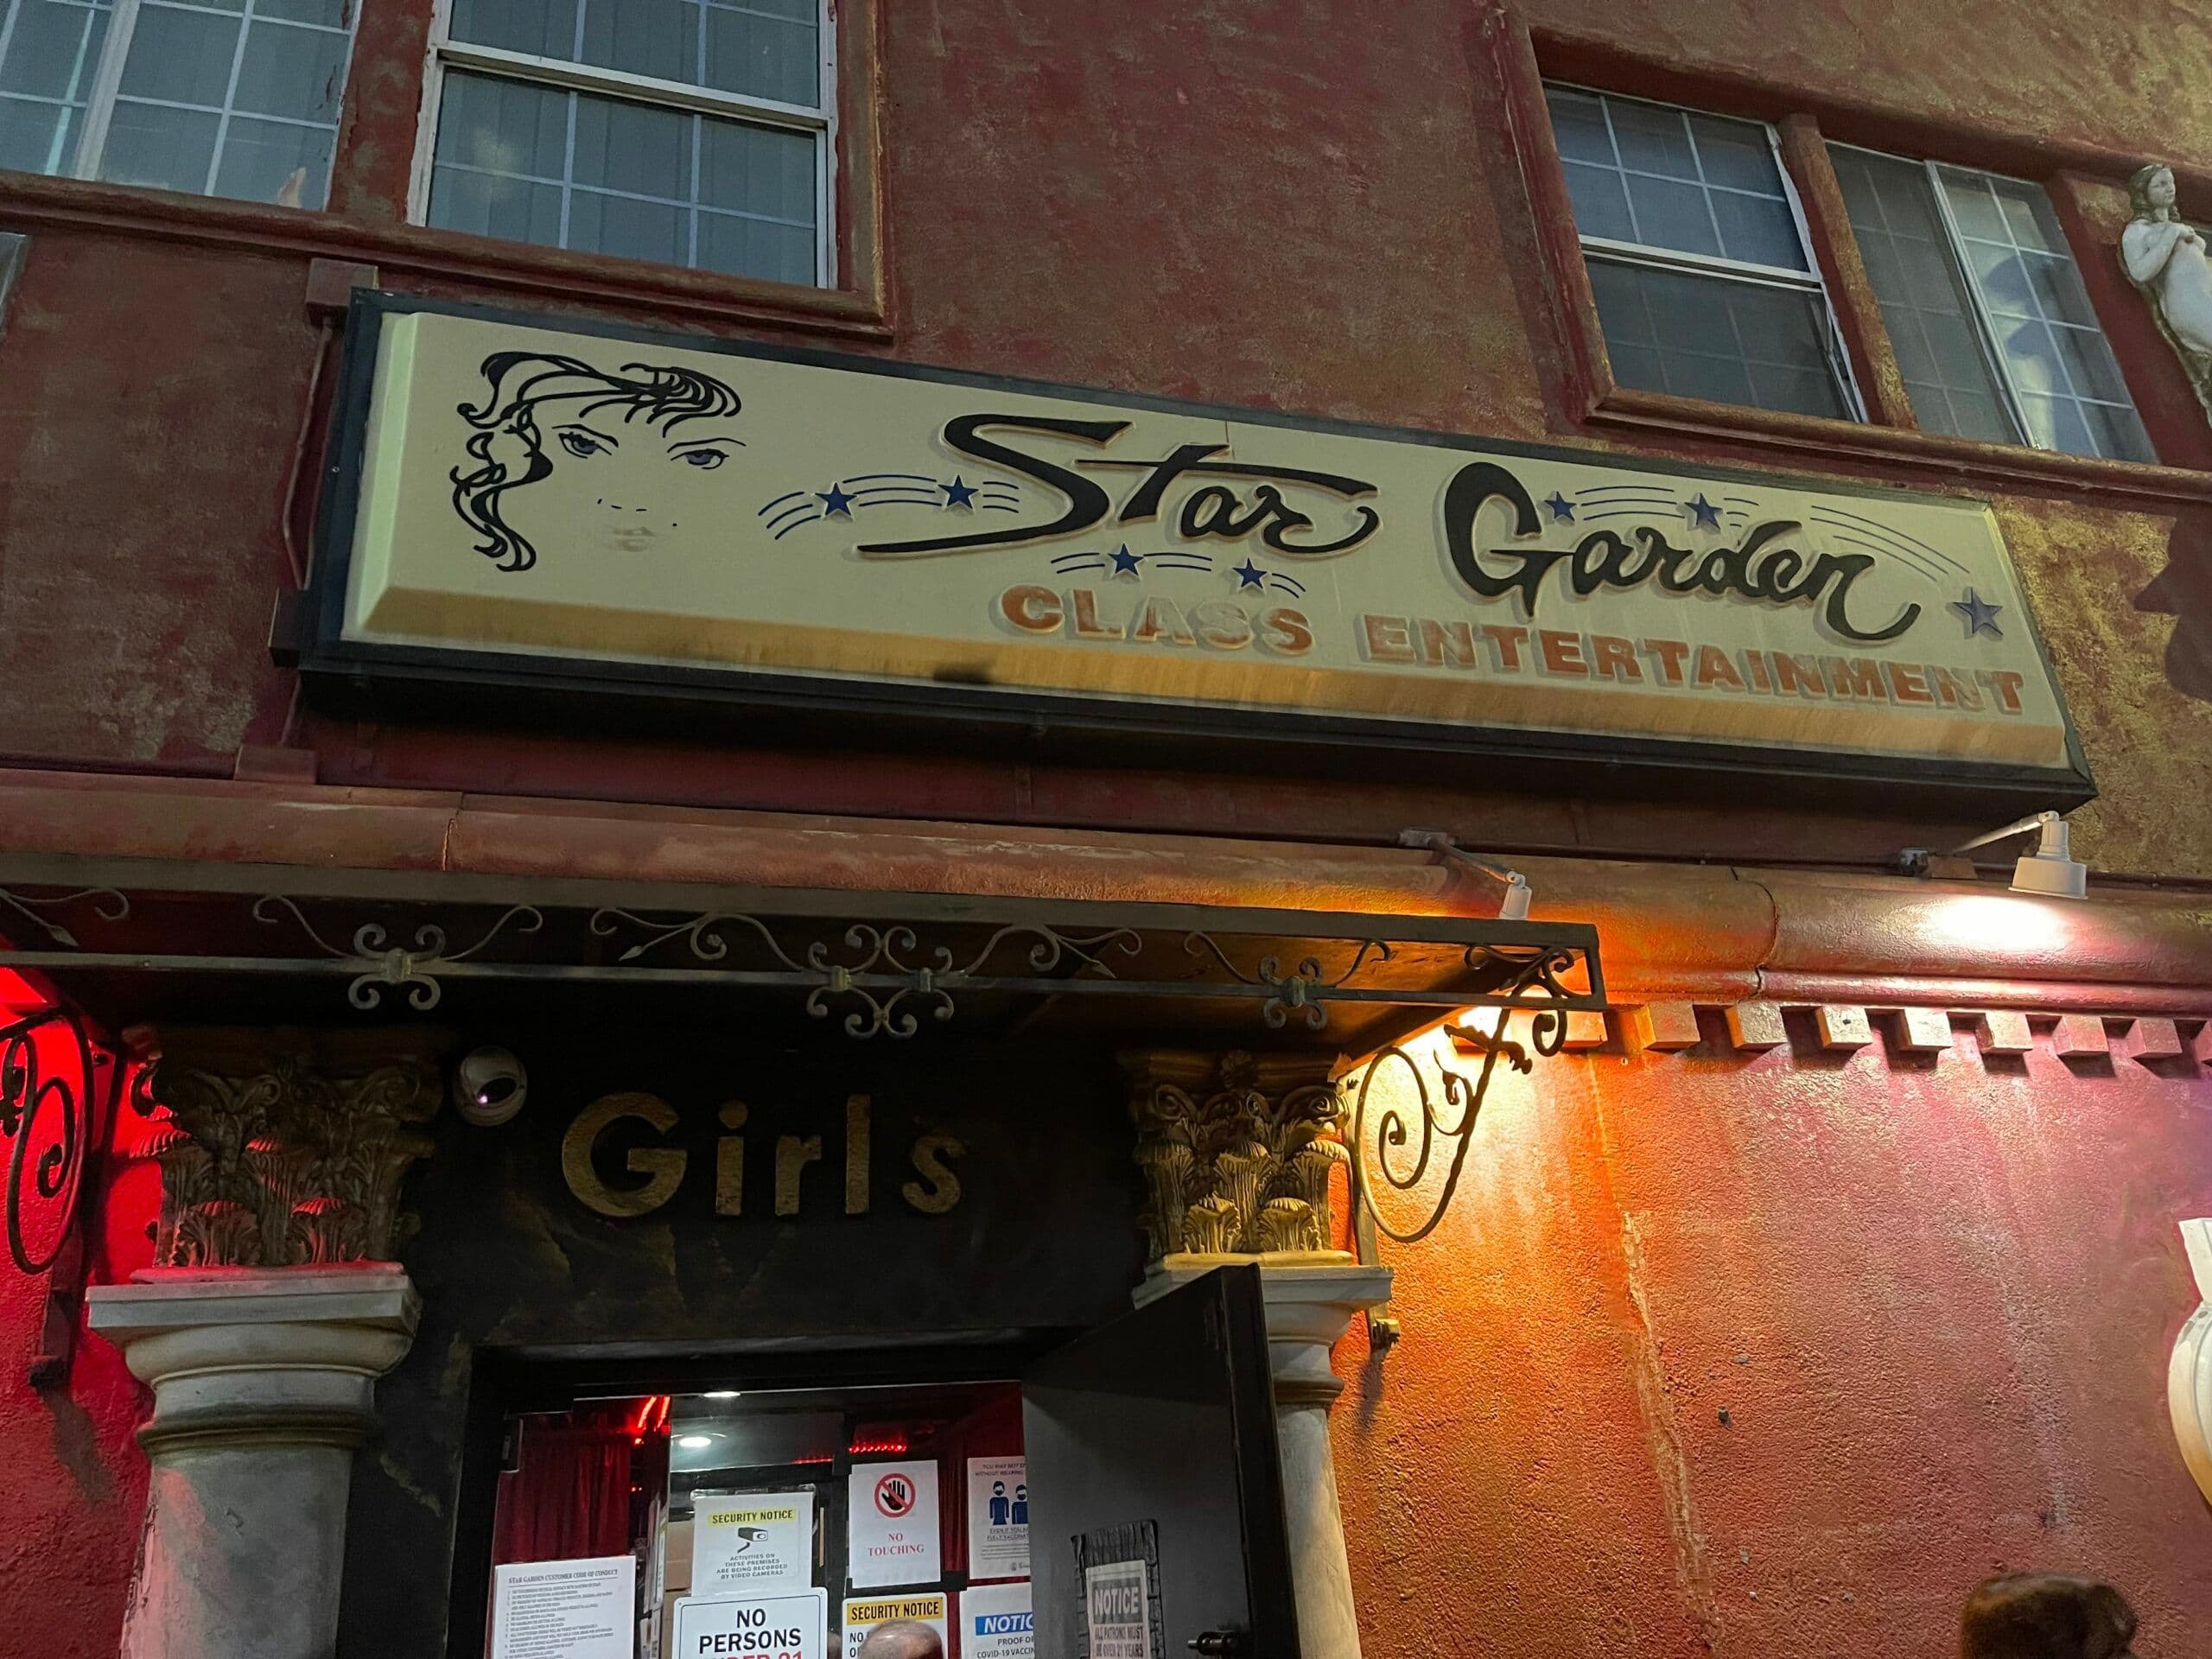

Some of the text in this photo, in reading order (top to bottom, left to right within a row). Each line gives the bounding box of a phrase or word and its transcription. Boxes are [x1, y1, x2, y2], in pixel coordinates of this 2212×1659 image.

[857, 414, 1922, 641] Star Garden
[1000, 584, 2025, 714] CLASS ENTERTAINMENT
[562, 1092, 966, 1217] Girls
[712, 1510, 793, 1524] SECURITY NOTICE
[888, 1532, 904, 1542] NO
[868, 1544, 925, 1556] TOUCHING
[851, 1601, 939, 1621] SECURITY NOTICE
[1094, 1586, 1139, 1616] NOTICE
[736, 1608, 766, 1629] NO
[984, 1613, 1033, 1634] NOTIC
[699, 1627, 802, 1654] PERSONS
[849, 1631, 864, 1643] NO
[997, 1637, 1024, 1646] PROOF
[976, 1647, 1035, 1659] COVID-19 VACCIN
